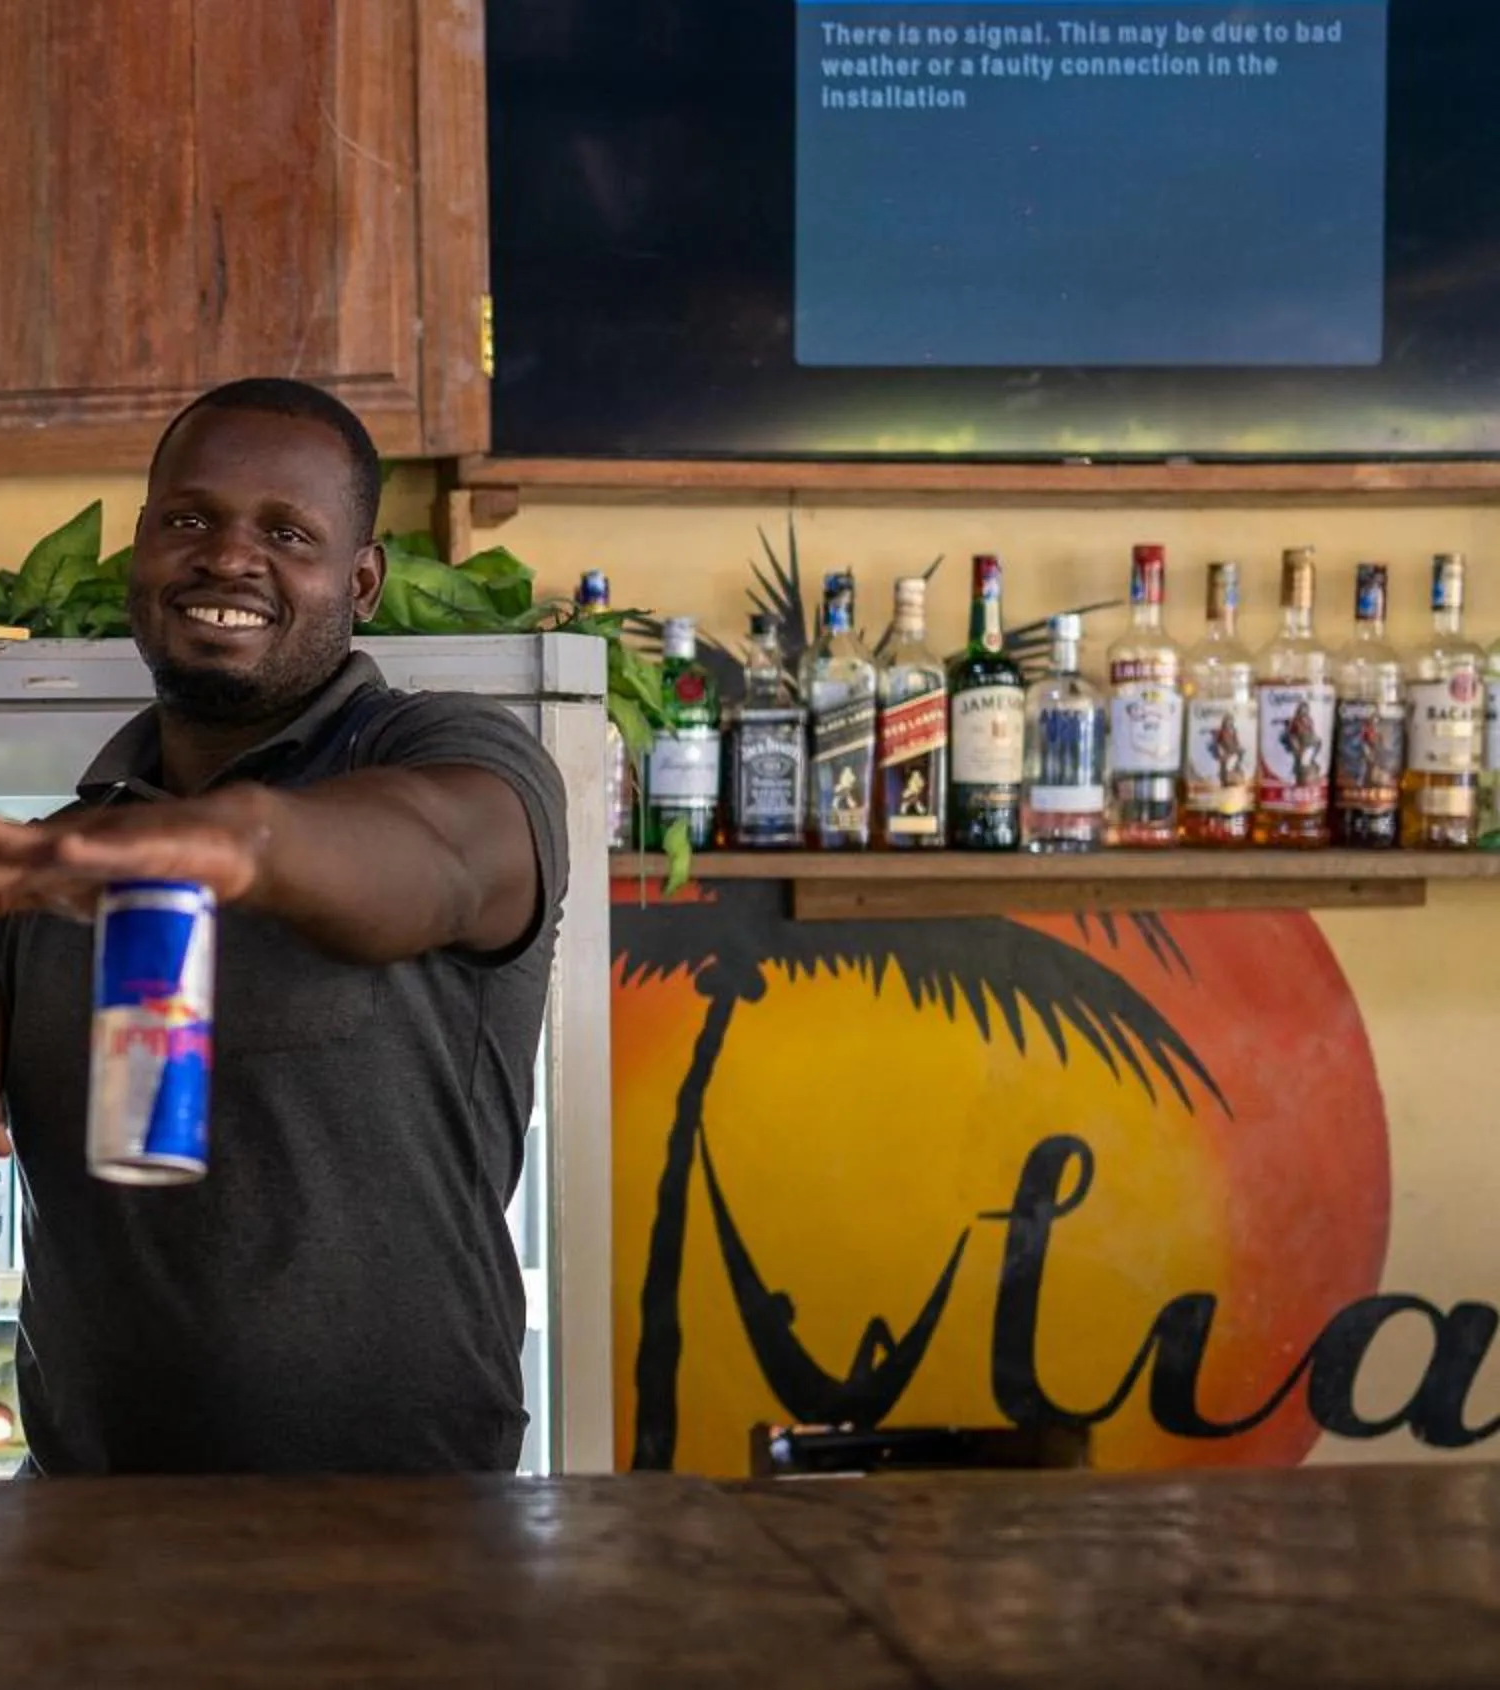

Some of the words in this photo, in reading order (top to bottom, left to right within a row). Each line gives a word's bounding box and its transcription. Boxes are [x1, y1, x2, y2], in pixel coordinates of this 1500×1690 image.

[822, 21, 892, 45] There
[899, 22, 920, 44] is
[927, 26, 958, 44] no
[964, 21, 1051, 49] signal.
[1058, 21, 1111, 44] This
[1118, 25, 1167, 48] may
[1176, 20, 1206, 43] be
[1211, 21, 1258, 43] due
[1264, 22, 1289, 43] to
[1296, 20, 1342, 42] bad
[821, 54, 921, 76] weather
[928, 58, 953, 76] or
[960, 58, 974, 76] a
[981, 54, 1053, 81] faulty
[1060, 53, 1200, 75] connection
[1208, 53, 1231, 75] in
[1237, 53, 1278, 75] the
[821, 85, 967, 108] installation
